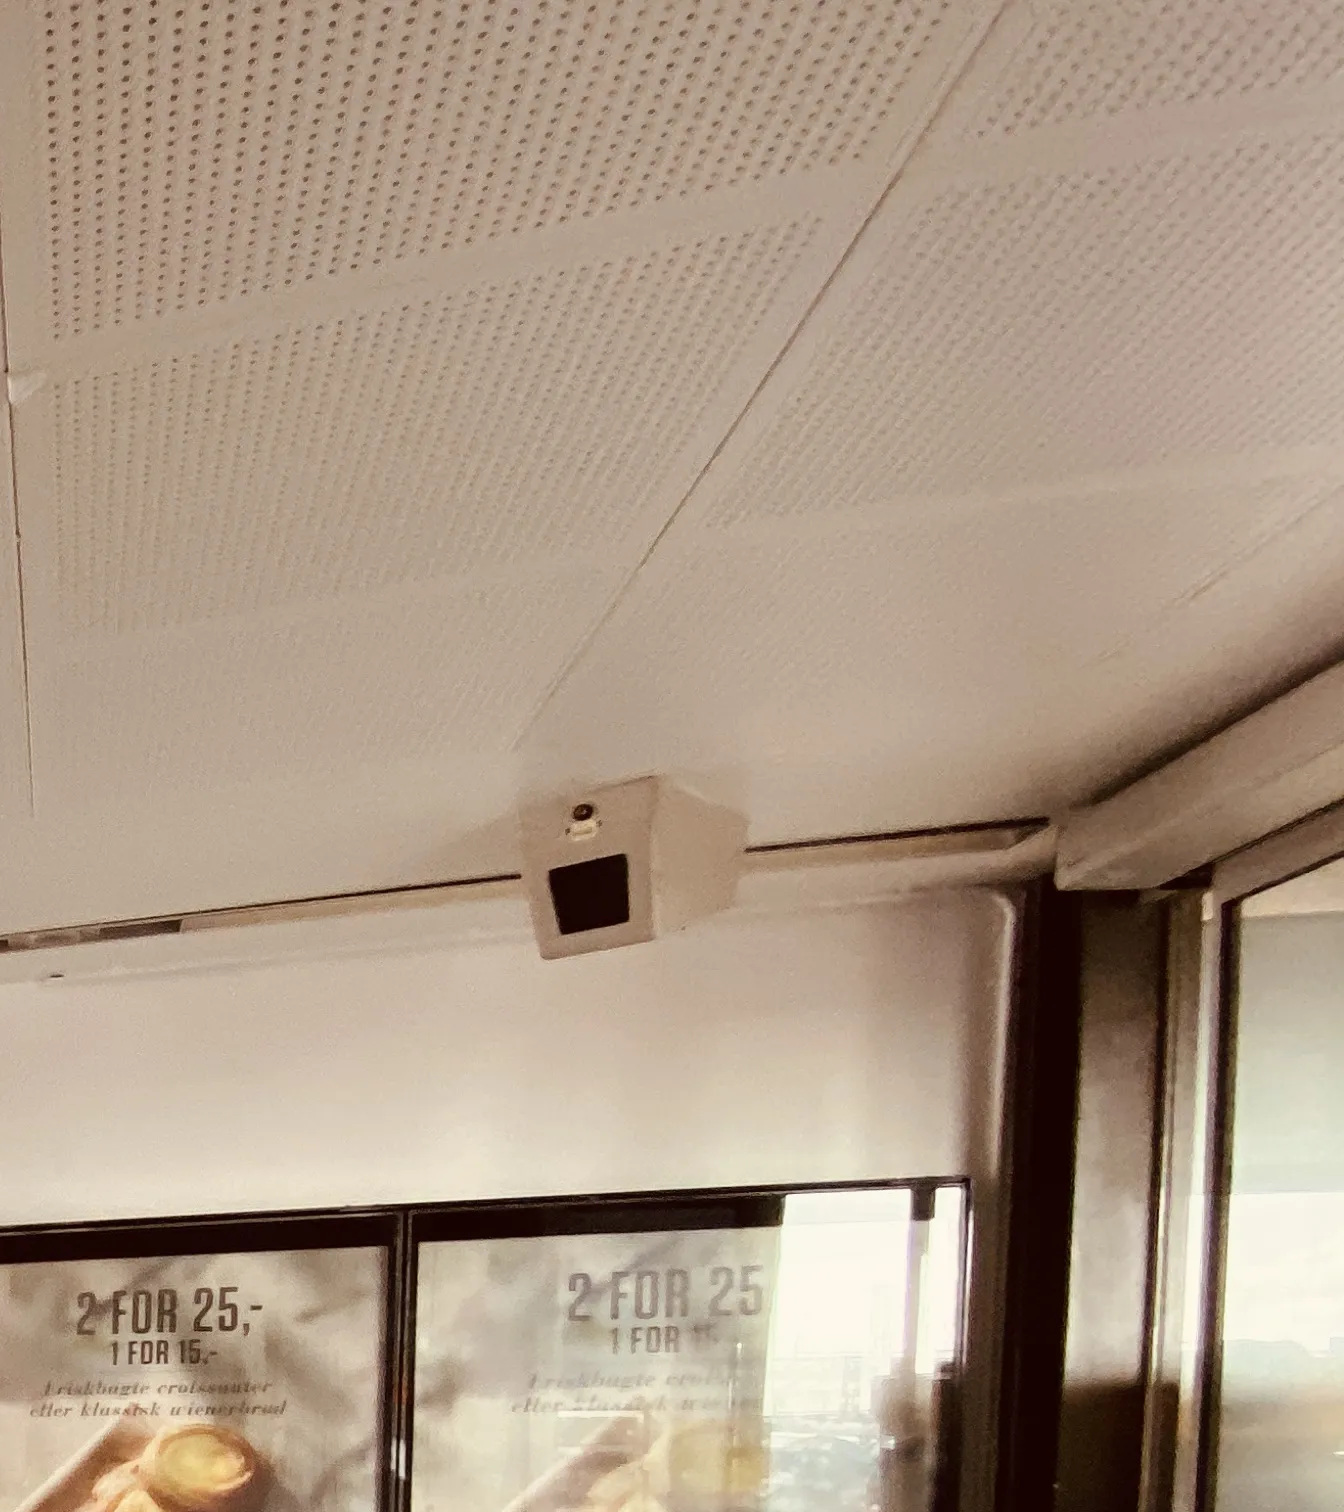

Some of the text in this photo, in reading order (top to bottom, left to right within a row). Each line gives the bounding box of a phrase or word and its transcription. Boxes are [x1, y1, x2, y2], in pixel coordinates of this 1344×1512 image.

[76, 1286, 263, 1336] 2 FOR 25,-
[568, 1273, 593, 1322] 2
[610, 1268, 689, 1320] FOR
[111, 1341, 119, 1366] 1
[128, 1339, 169, 1365] FOR
[630, 1325, 680, 1354] FOR
